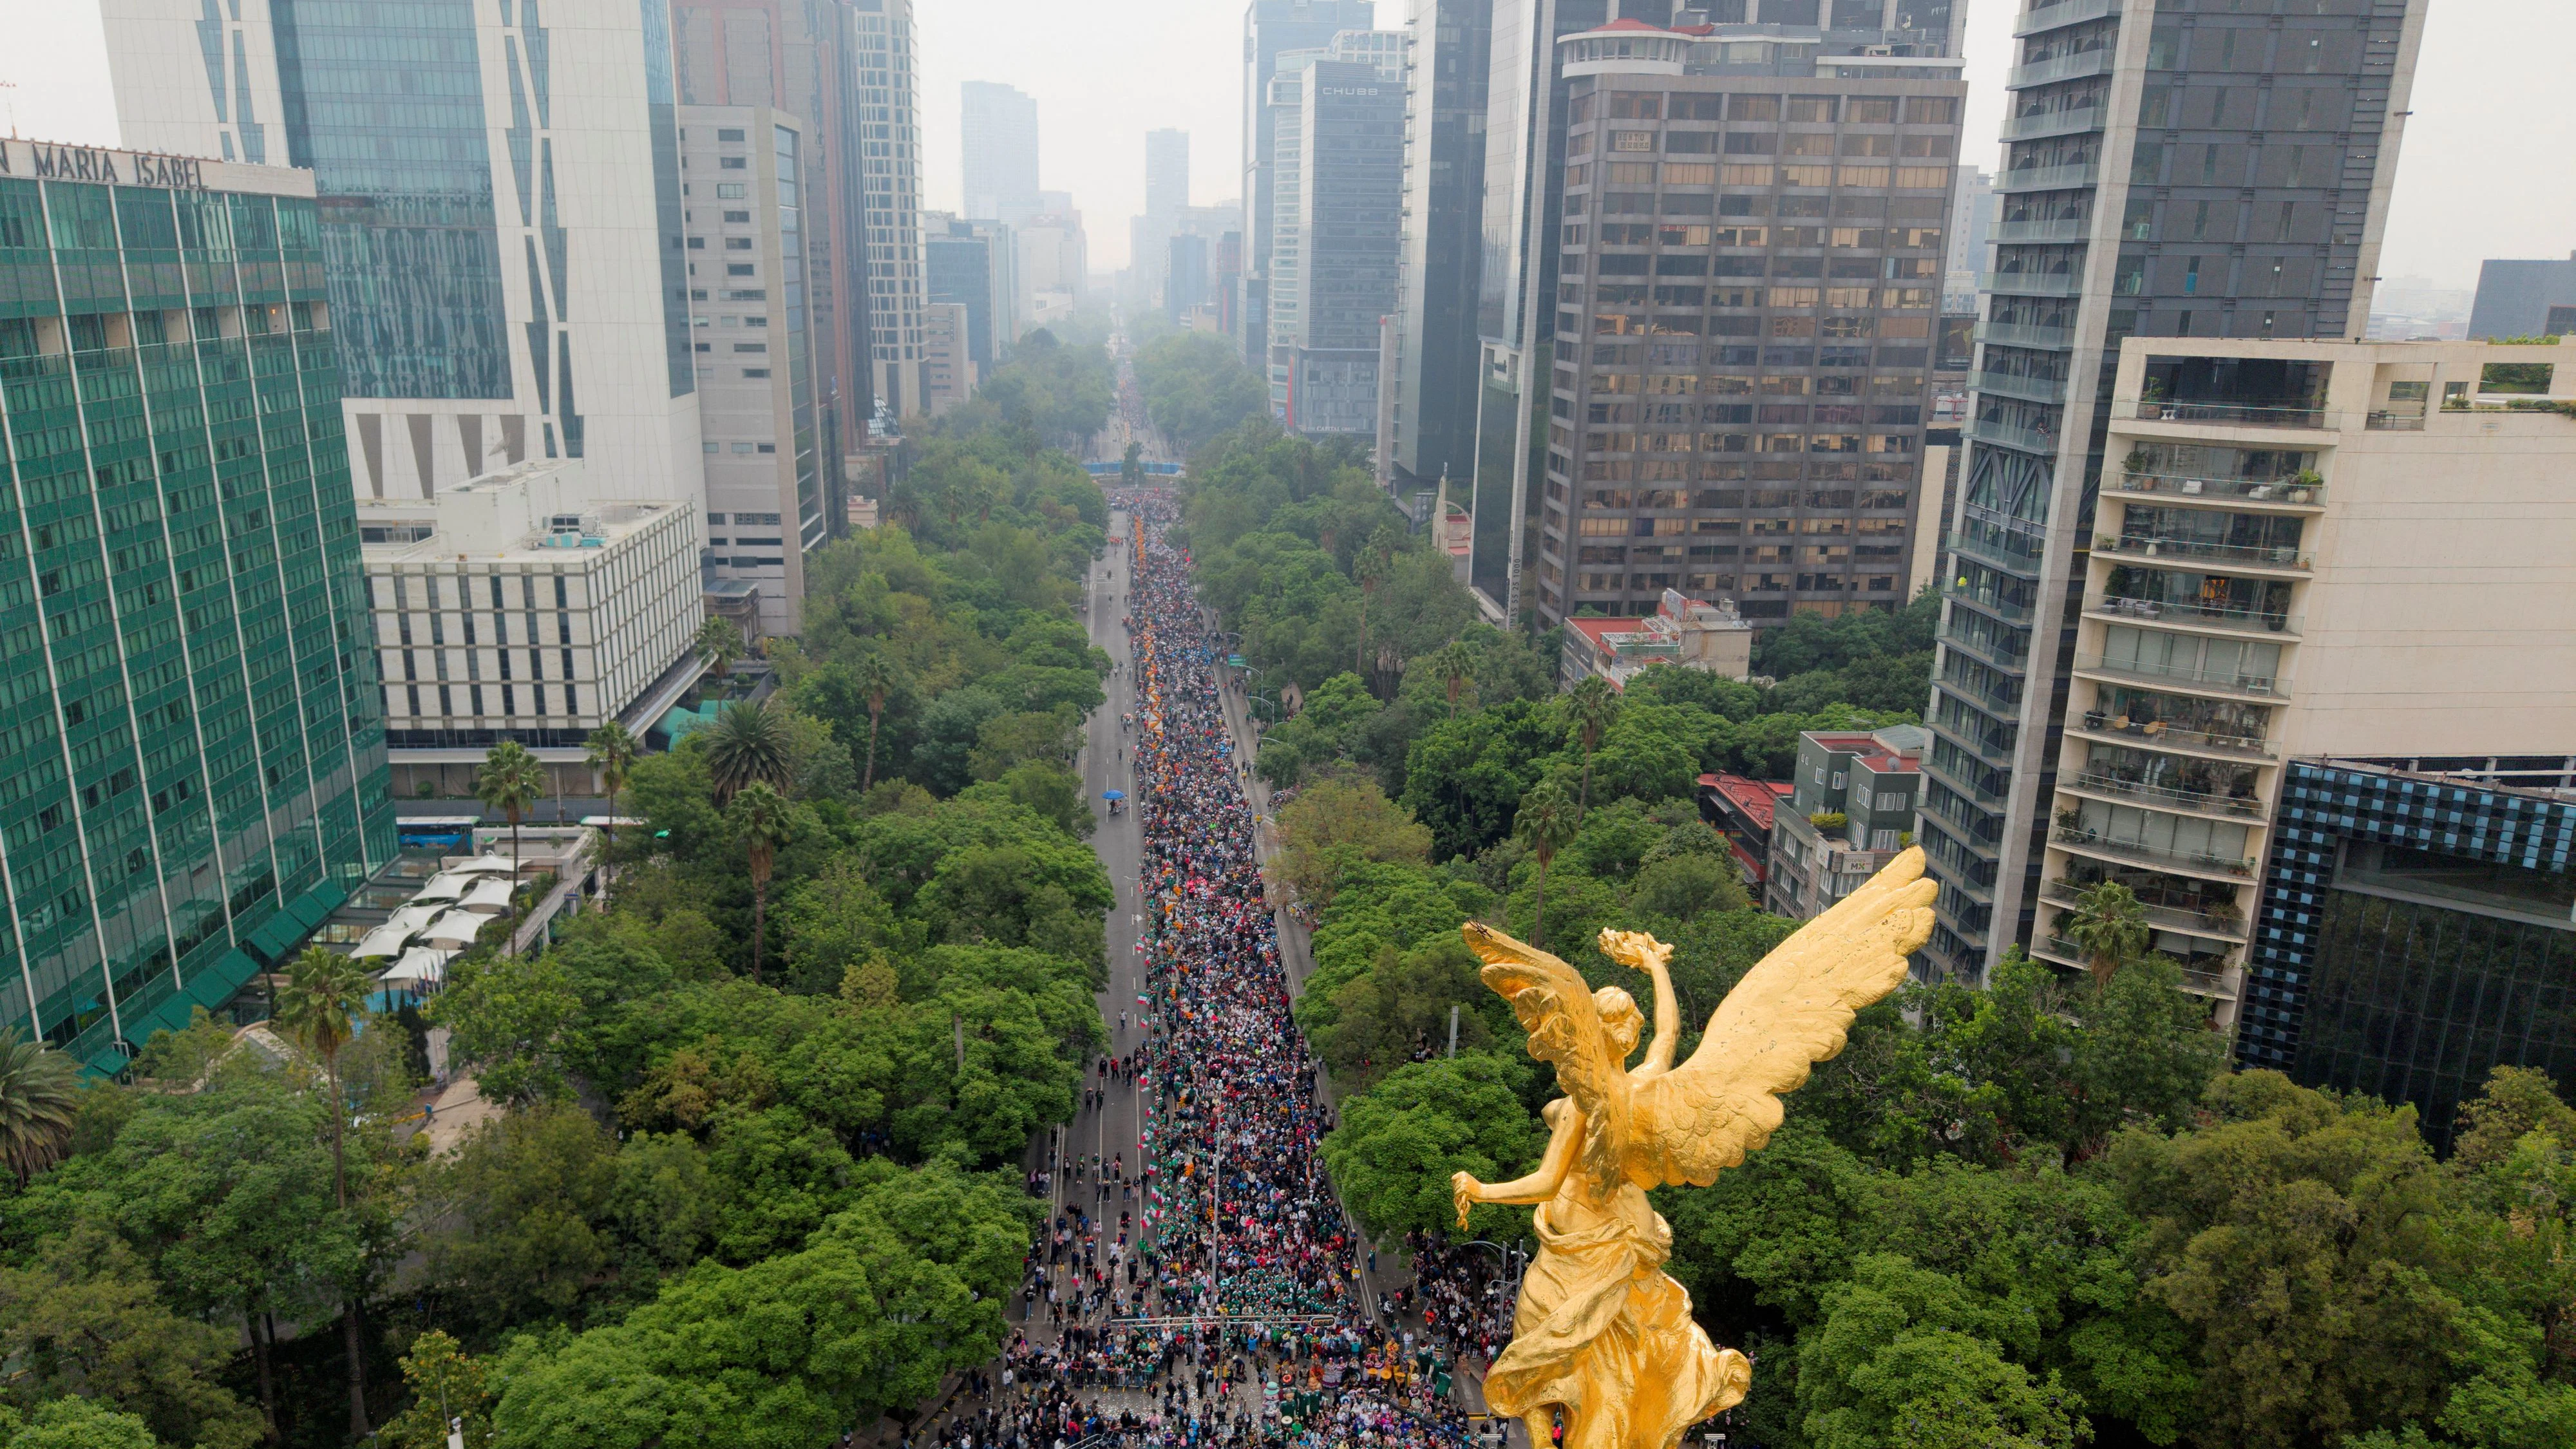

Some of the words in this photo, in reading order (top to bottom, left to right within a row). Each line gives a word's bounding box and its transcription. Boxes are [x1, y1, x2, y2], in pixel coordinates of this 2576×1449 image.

[1322, 87, 1378, 96] CHUBB
[32, 143, 118, 183] MARIA
[133, 153, 209, 189] ISABEL
[1512, 582, 1519, 591] 25
[1511, 594, 1519, 603] 55
